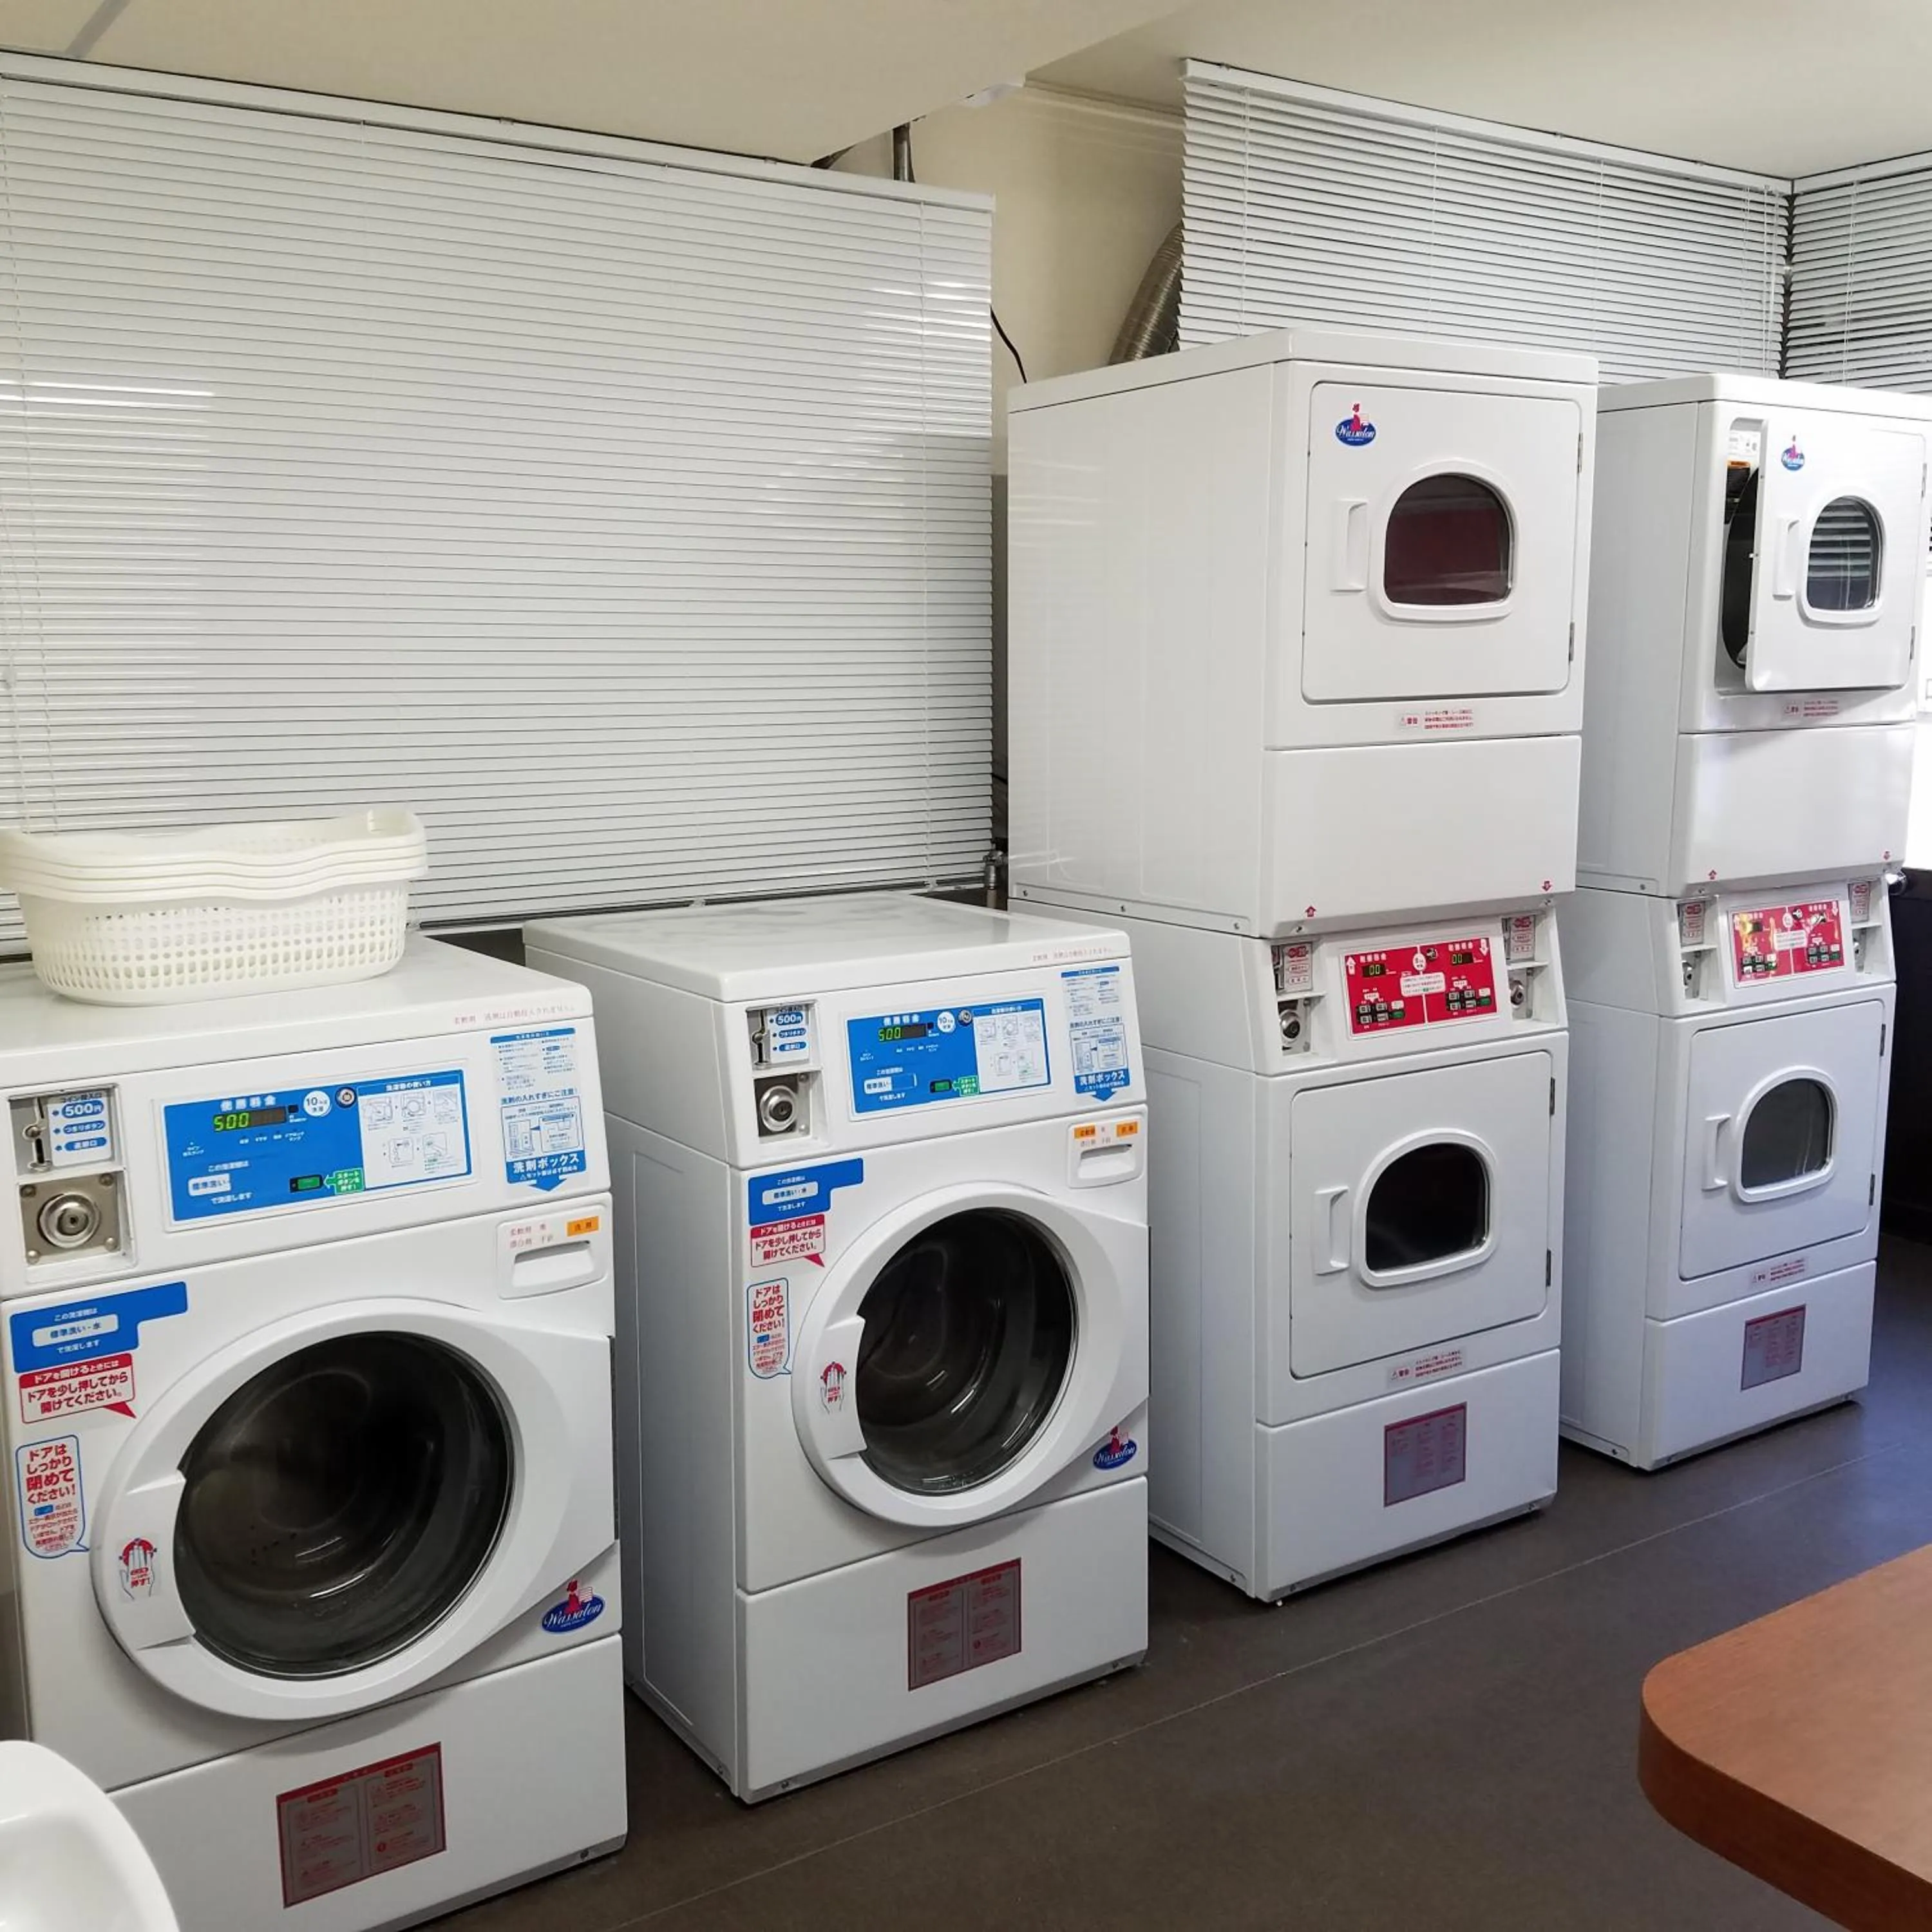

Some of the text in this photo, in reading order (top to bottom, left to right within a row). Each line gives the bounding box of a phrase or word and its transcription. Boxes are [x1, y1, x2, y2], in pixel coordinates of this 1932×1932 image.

[878, 1027, 902, 1041] 500
[213, 1113, 249, 1132] 500
[513, 1152, 580, 1173] 洗剤ボックス
[755, 1229, 822, 1251] ドアを少し押してから
[755, 1284, 781, 1299] ドアは
[753, 1295, 784, 1309] しっかり
[752, 1306, 785, 1323] 閉めて
[34, 1359, 120, 1384] ドアを開けるときには
[28, 1372, 129, 1403] ドアを少し押してから
[29, 1444, 67, 1462] ドアは
[26, 1456, 72, 1475] しっかり
[25, 1468, 75, 1493] 閉めて
